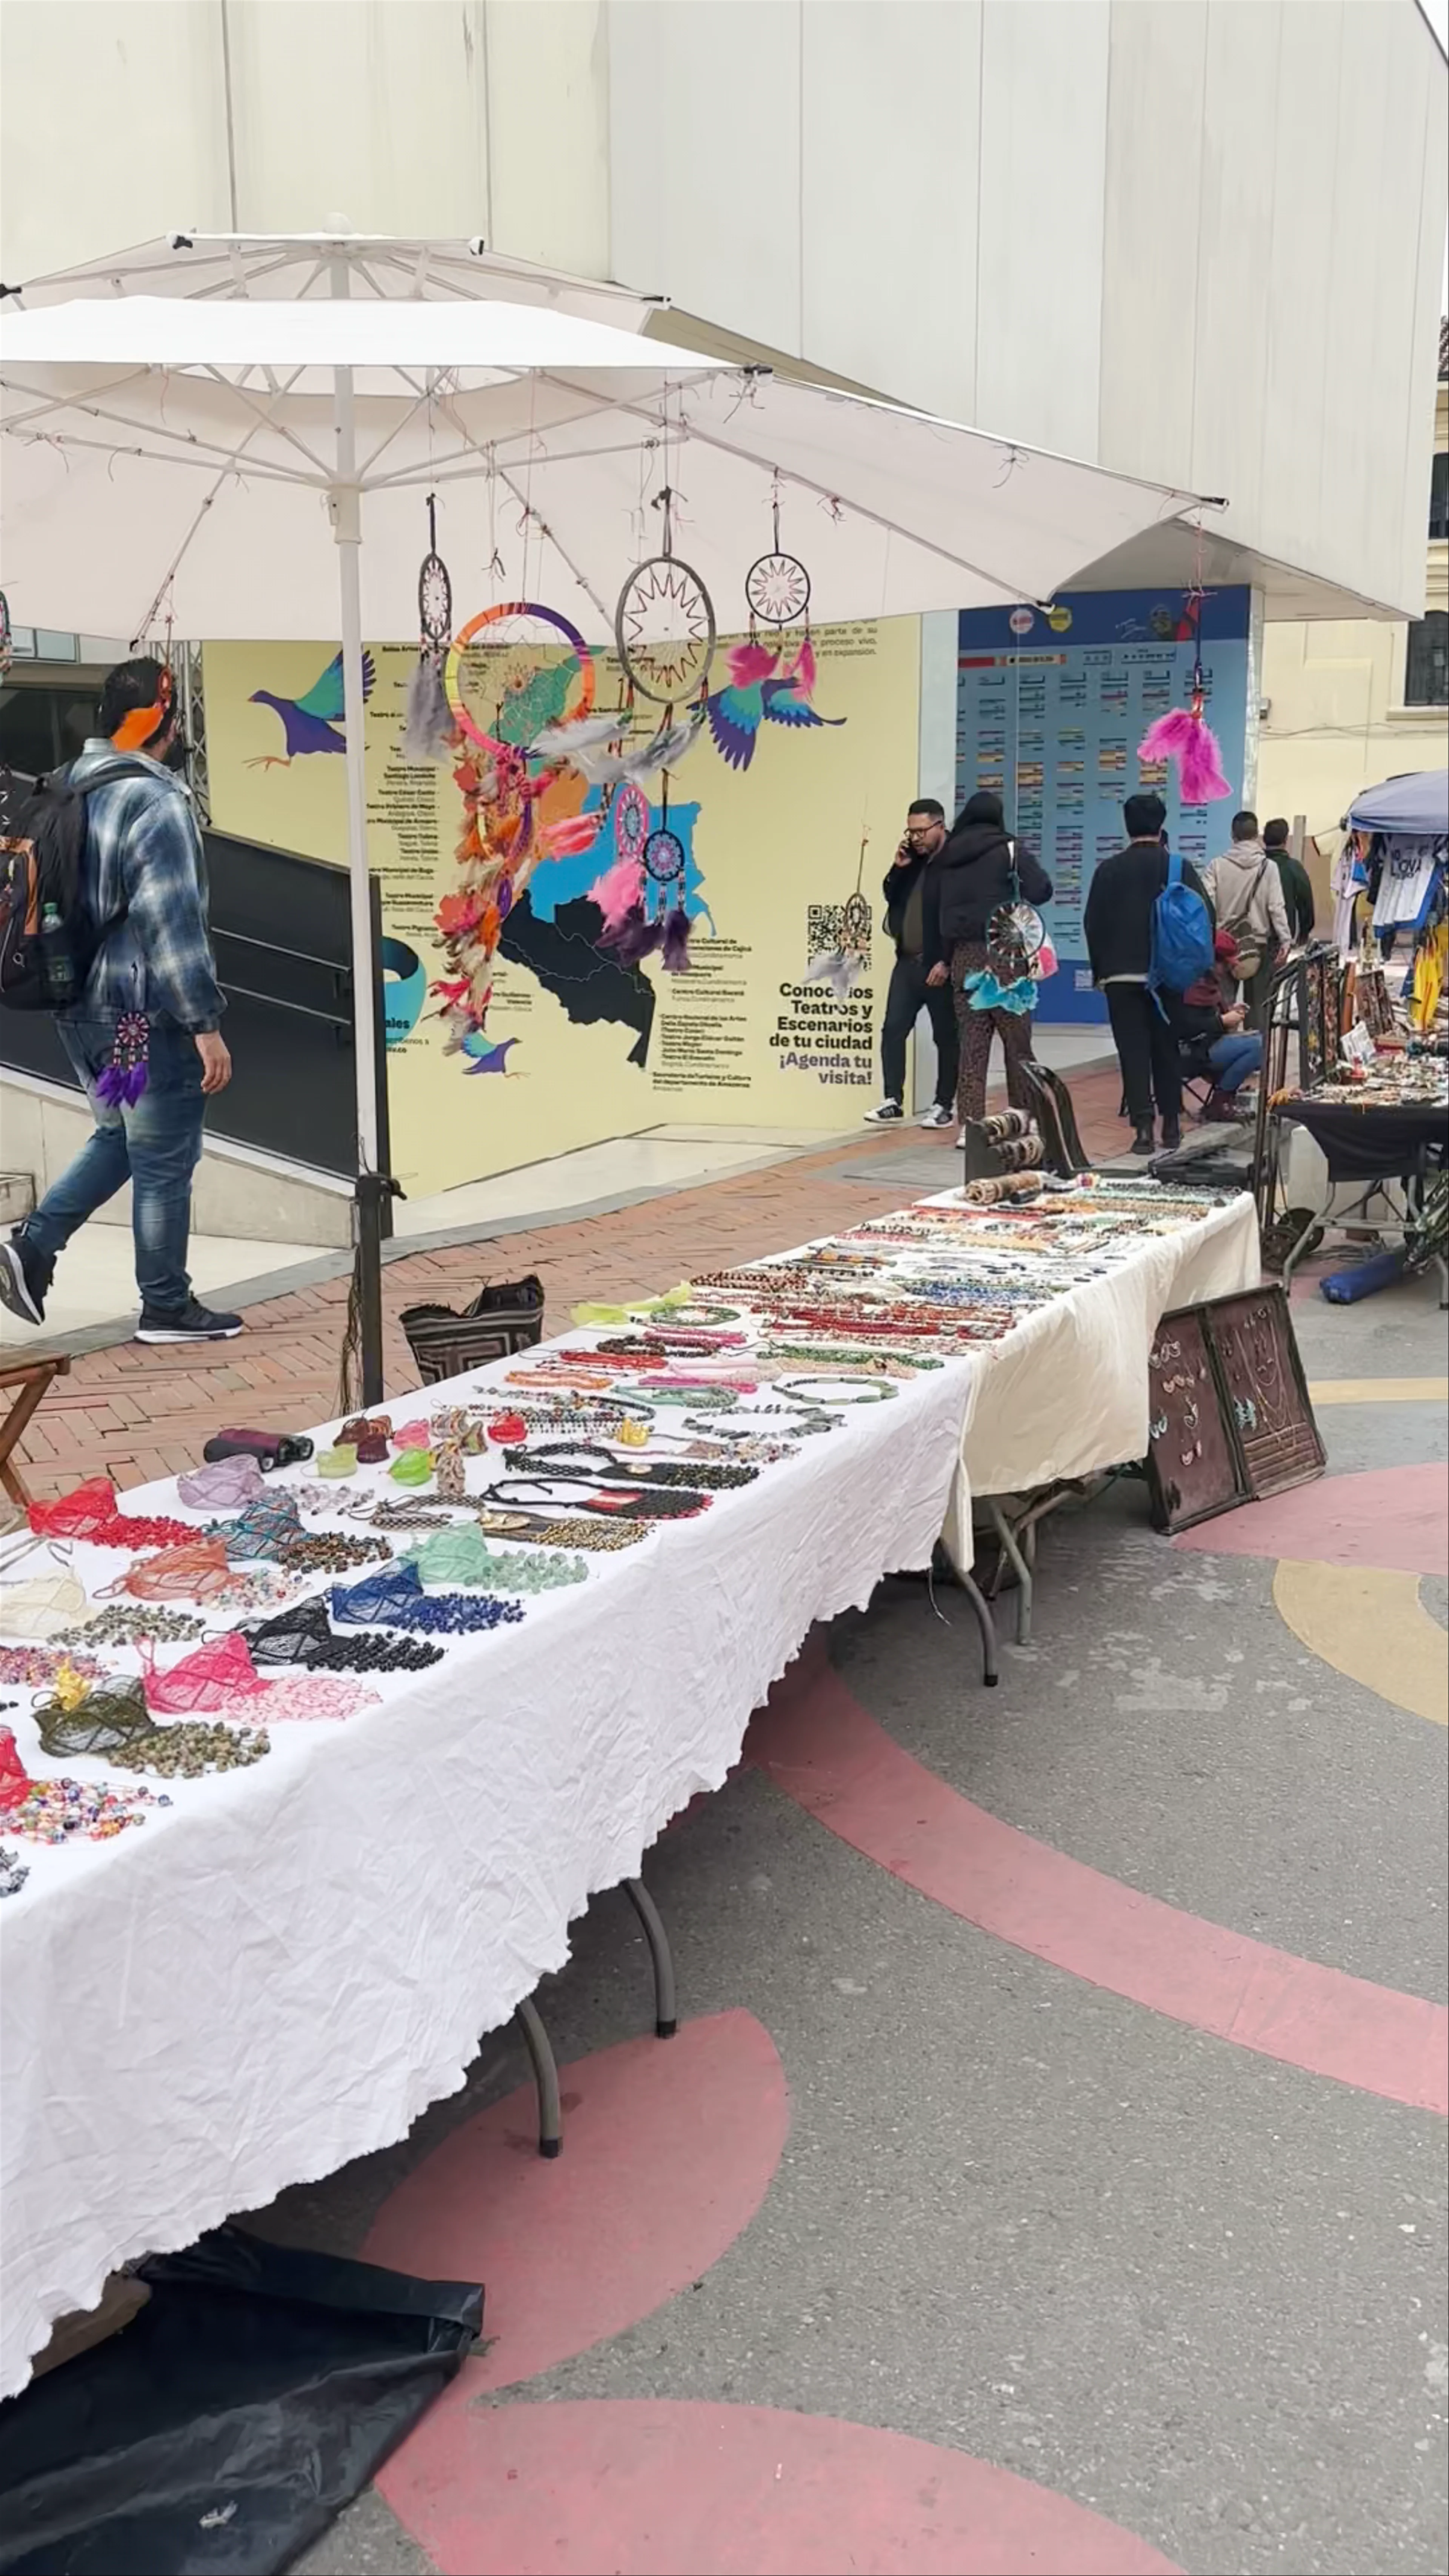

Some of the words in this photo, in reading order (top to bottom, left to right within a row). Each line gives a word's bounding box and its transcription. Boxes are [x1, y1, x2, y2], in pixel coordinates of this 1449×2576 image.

[824, 627, 846, 636] parte
[791, 1000, 858, 1016] Teatros
[861, 1005, 873, 1019] y
[777, 1016, 873, 1033] Escenarios
[769, 1033, 790, 1047] de
[793, 1035, 811, 1048] tu
[815, 1034, 872, 1050] ciudad
[780, 1052, 851, 1069] ¡Agenda
[854, 1055, 872, 1068] tu
[818, 1070, 872, 1085] visita!
